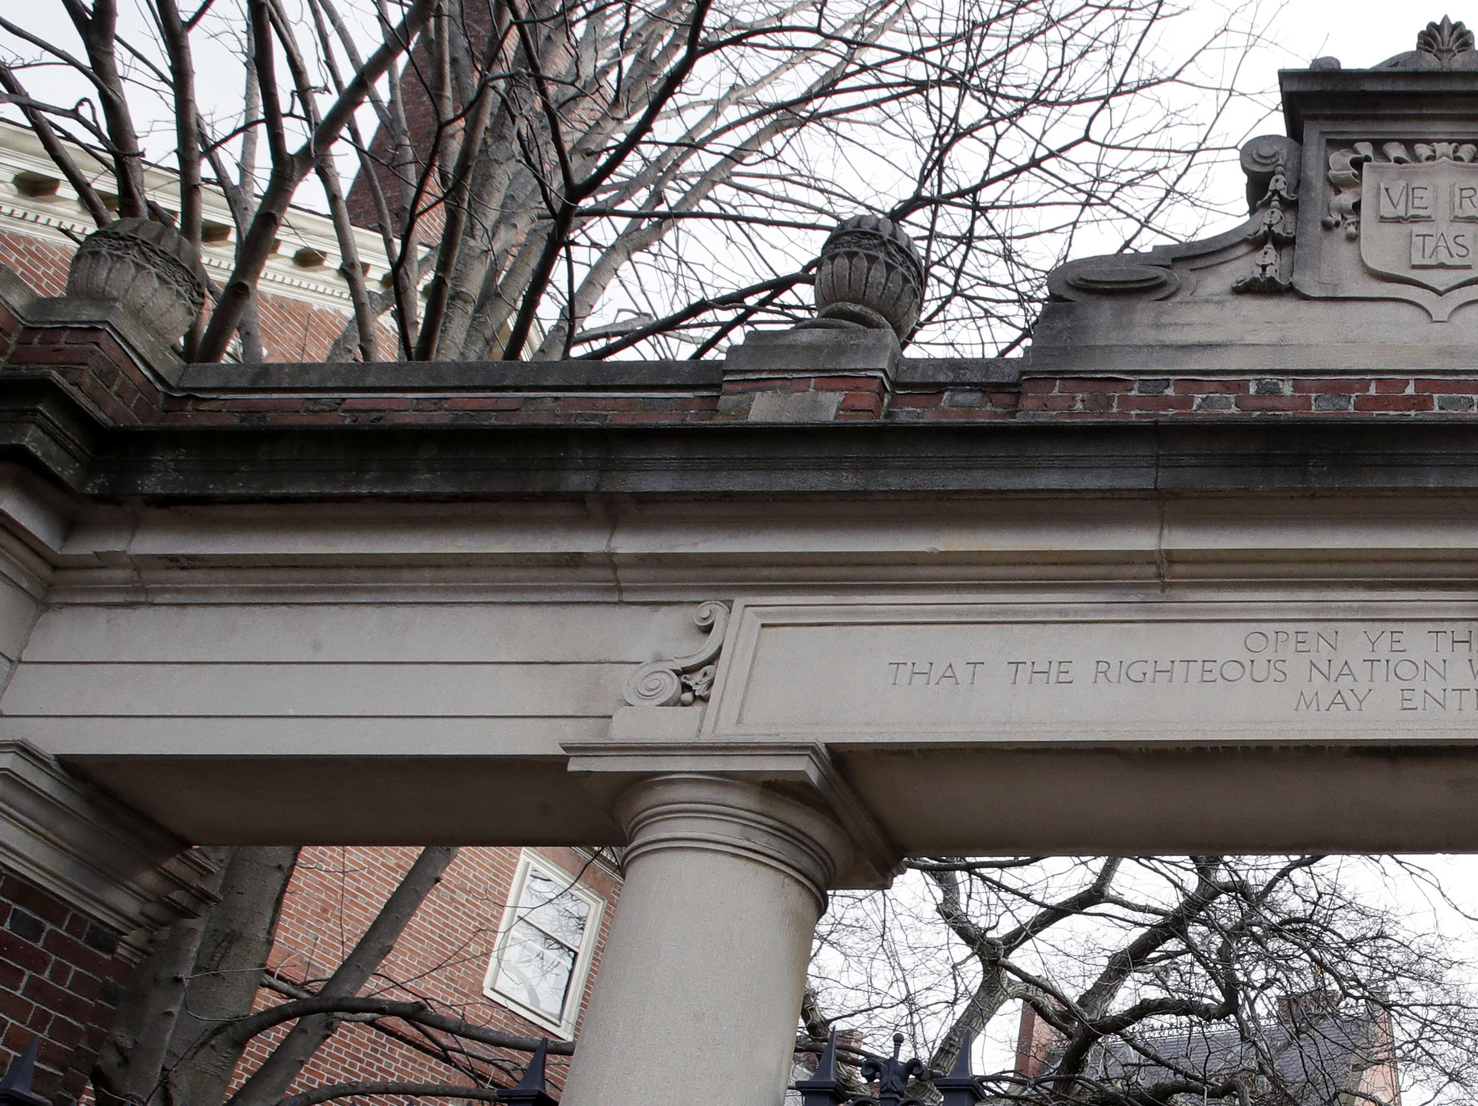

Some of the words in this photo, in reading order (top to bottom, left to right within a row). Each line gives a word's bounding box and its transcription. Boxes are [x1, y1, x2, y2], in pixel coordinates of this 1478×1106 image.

[1384, 186, 1428, 210] VE
[1415, 232, 1471, 259] TAS
[1244, 630, 1339, 653] OPEN
[1363, 630, 1407, 653] YE
[888, 661, 985, 686] THAT
[1007, 660, 1074, 685] THE
[1092, 659, 1288, 684] RIGHTEOUS
[1307, 659, 1448, 683] NATION
[1294, 688, 1374, 712] MAY
